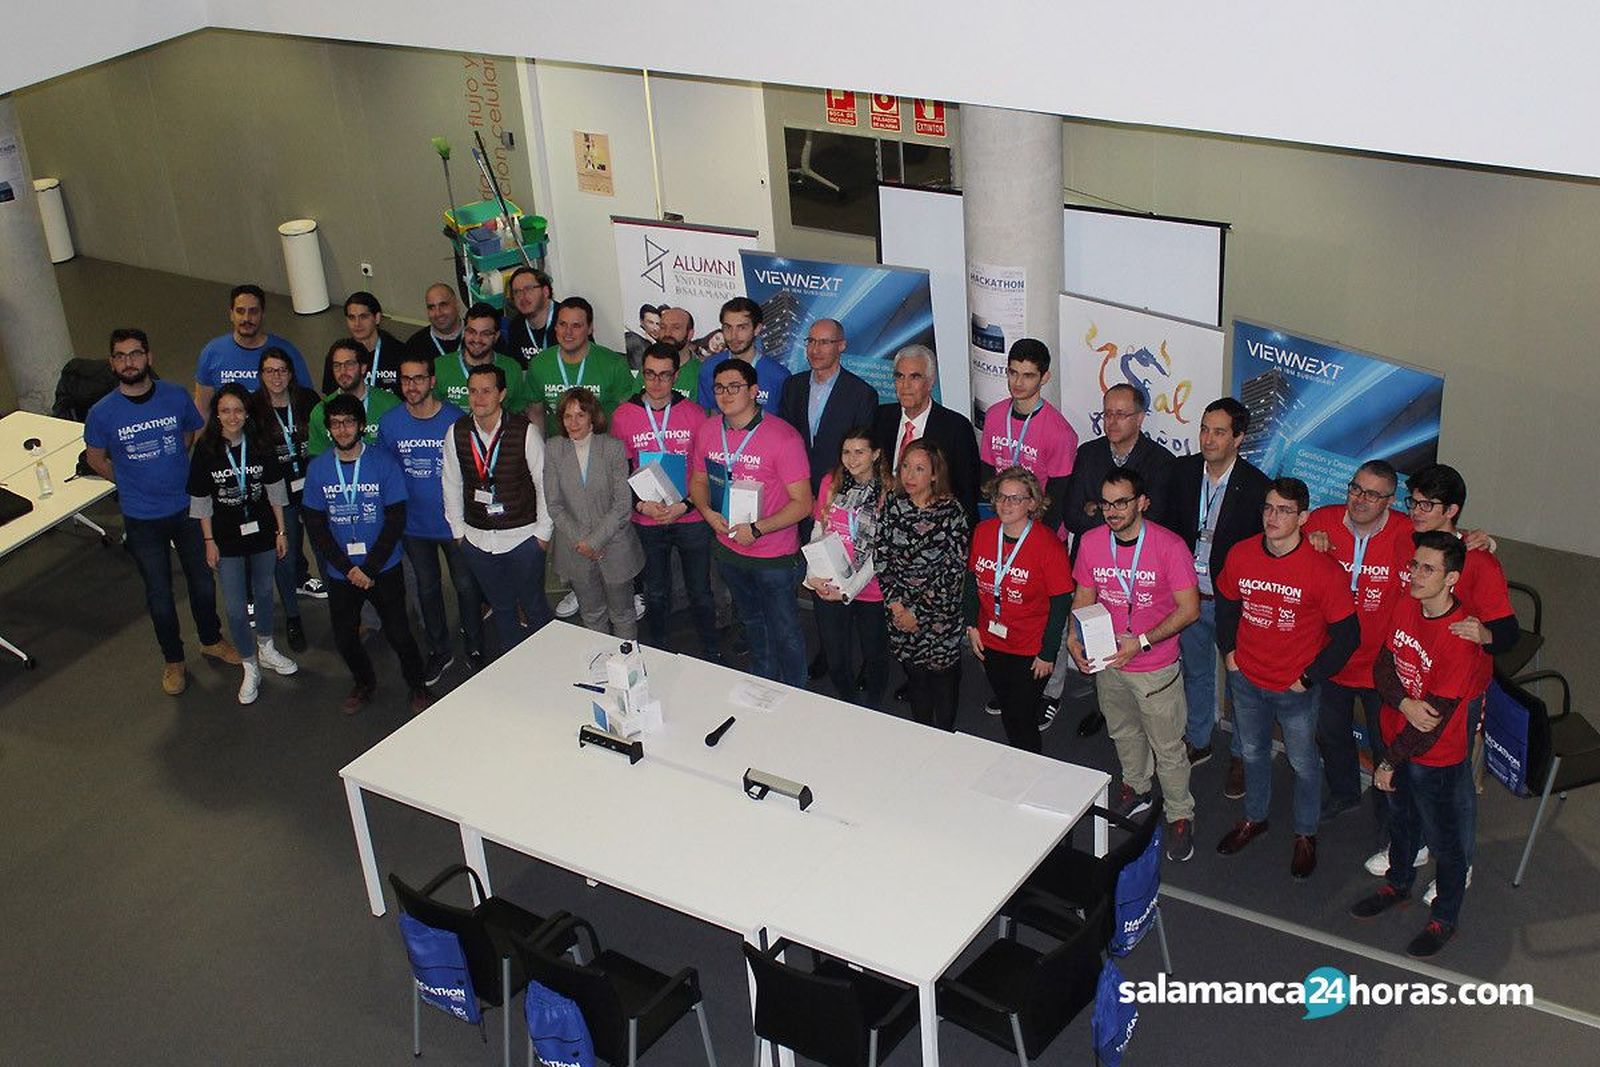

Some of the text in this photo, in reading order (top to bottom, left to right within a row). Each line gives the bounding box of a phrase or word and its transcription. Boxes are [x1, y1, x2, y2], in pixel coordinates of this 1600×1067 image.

[465, 77, 484, 127] flujo
[916, 122, 944, 133] EXTINTOR
[672, 255, 736, 277] ALUMNI
[754, 269, 843, 291] VIEWNEXT
[970, 272, 1024, 289] HACKATHON
[1247, 339, 1344, 380] VIEWNEXT
[118, 415, 178, 436] HACKATHON
[1238, 578, 1302, 598] HACKATHON
